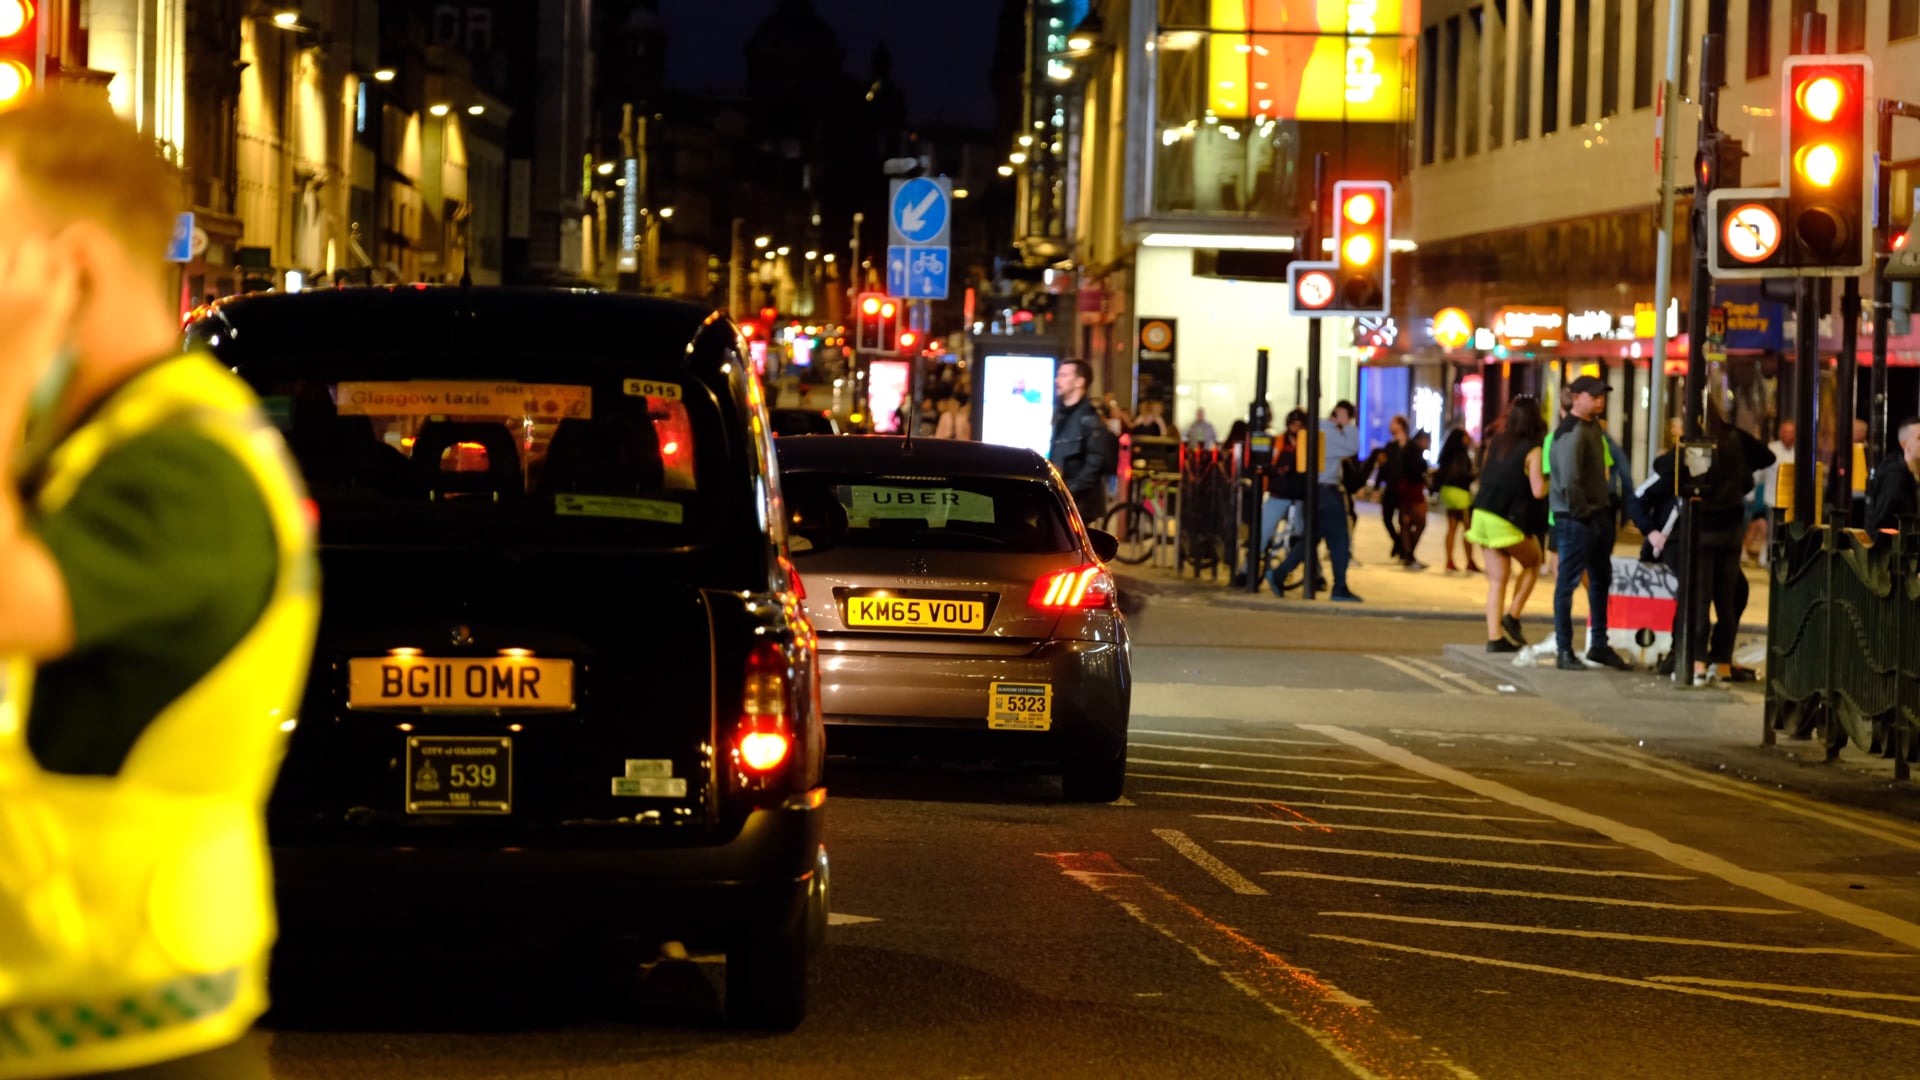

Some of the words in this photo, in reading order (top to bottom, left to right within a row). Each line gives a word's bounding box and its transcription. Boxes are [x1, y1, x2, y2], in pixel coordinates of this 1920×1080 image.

[630, 382, 676, 397] 5015
[351, 391, 438, 407] Glasgow
[445, 391, 490, 406] taxis
[873, 492, 960, 506] UBER
[860, 601, 920, 621] KM65
[929, 603, 972, 624] VOU
[381, 665, 452, 698] BG11
[465, 665, 541, 699] OMR
[1008, 696, 1046, 713] 5323
[450, 764, 496, 787] 539
